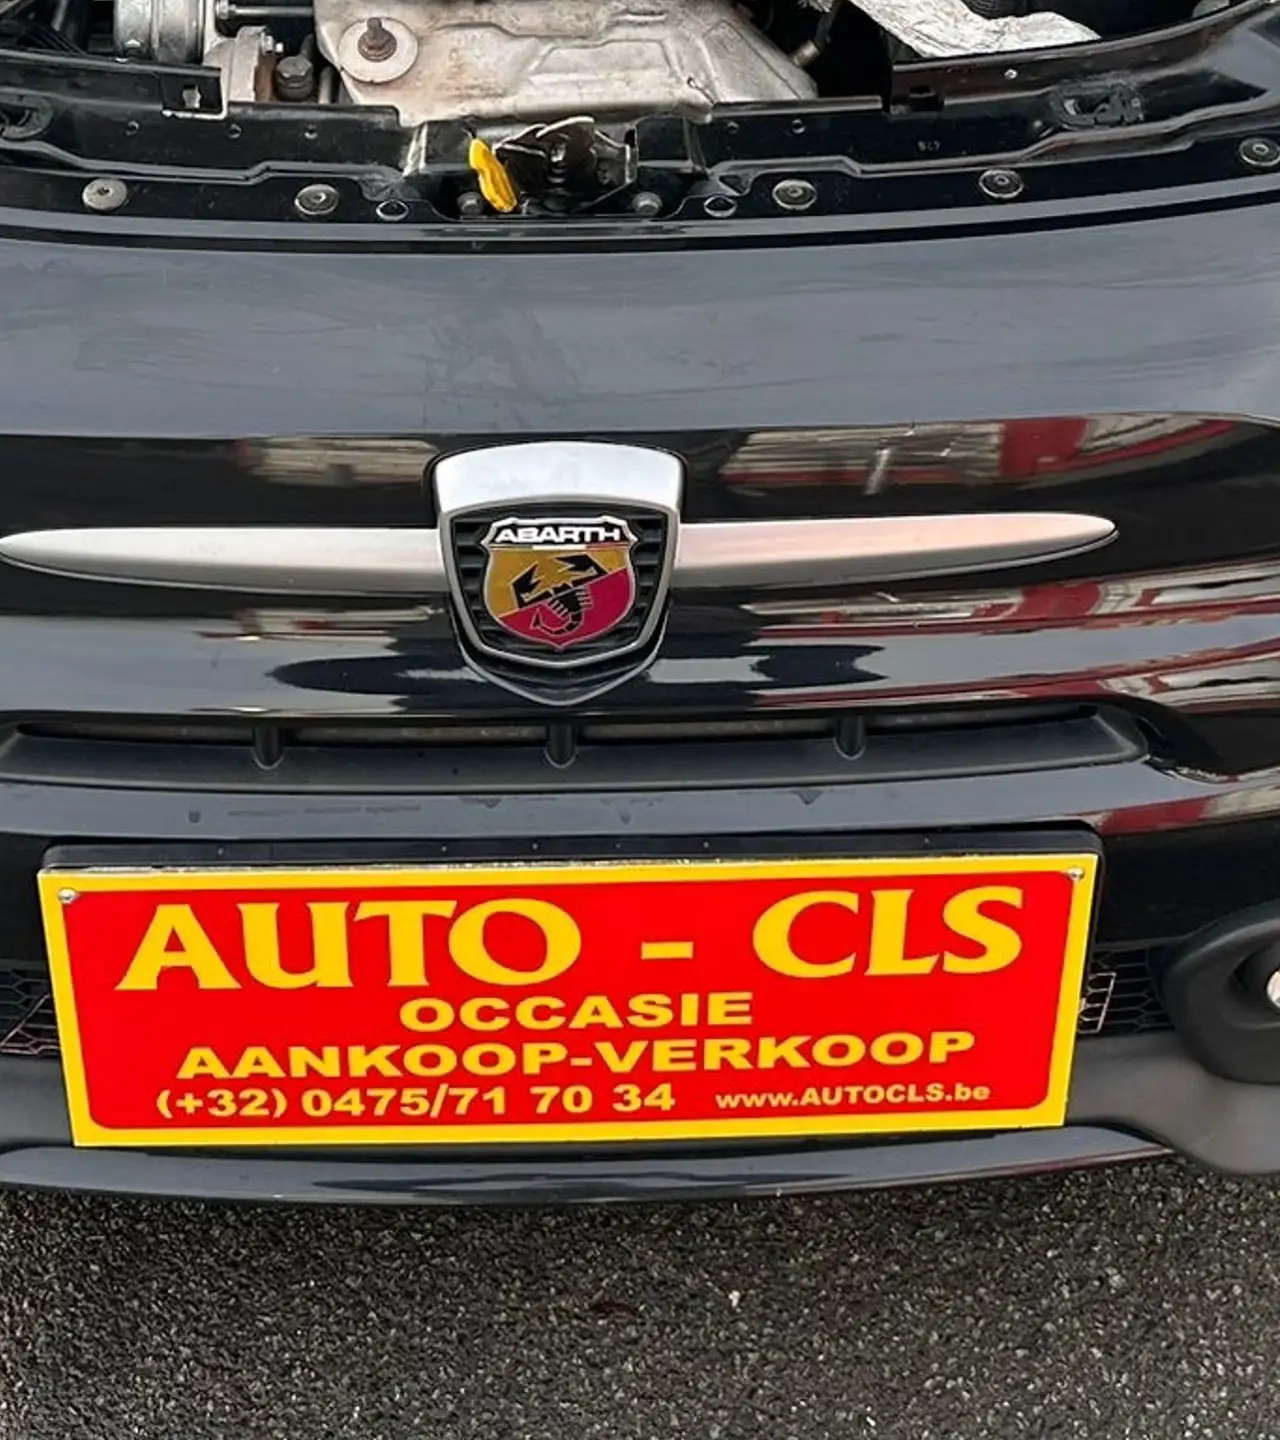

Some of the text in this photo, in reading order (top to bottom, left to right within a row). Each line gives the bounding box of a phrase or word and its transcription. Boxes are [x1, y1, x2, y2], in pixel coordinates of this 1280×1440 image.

[495, 525, 620, 543] ABARTH
[115, 898, 581, 991] AUTO
[752, 885, 1023, 978] CLS
[399, 991, 753, 1032] OCCASIE
[176, 1030, 975, 1080] AANKOOP-VERKOOP
[156, 1082, 991, 1119] (+32) 0475/71 70 34 www.AUTOCLS.be
